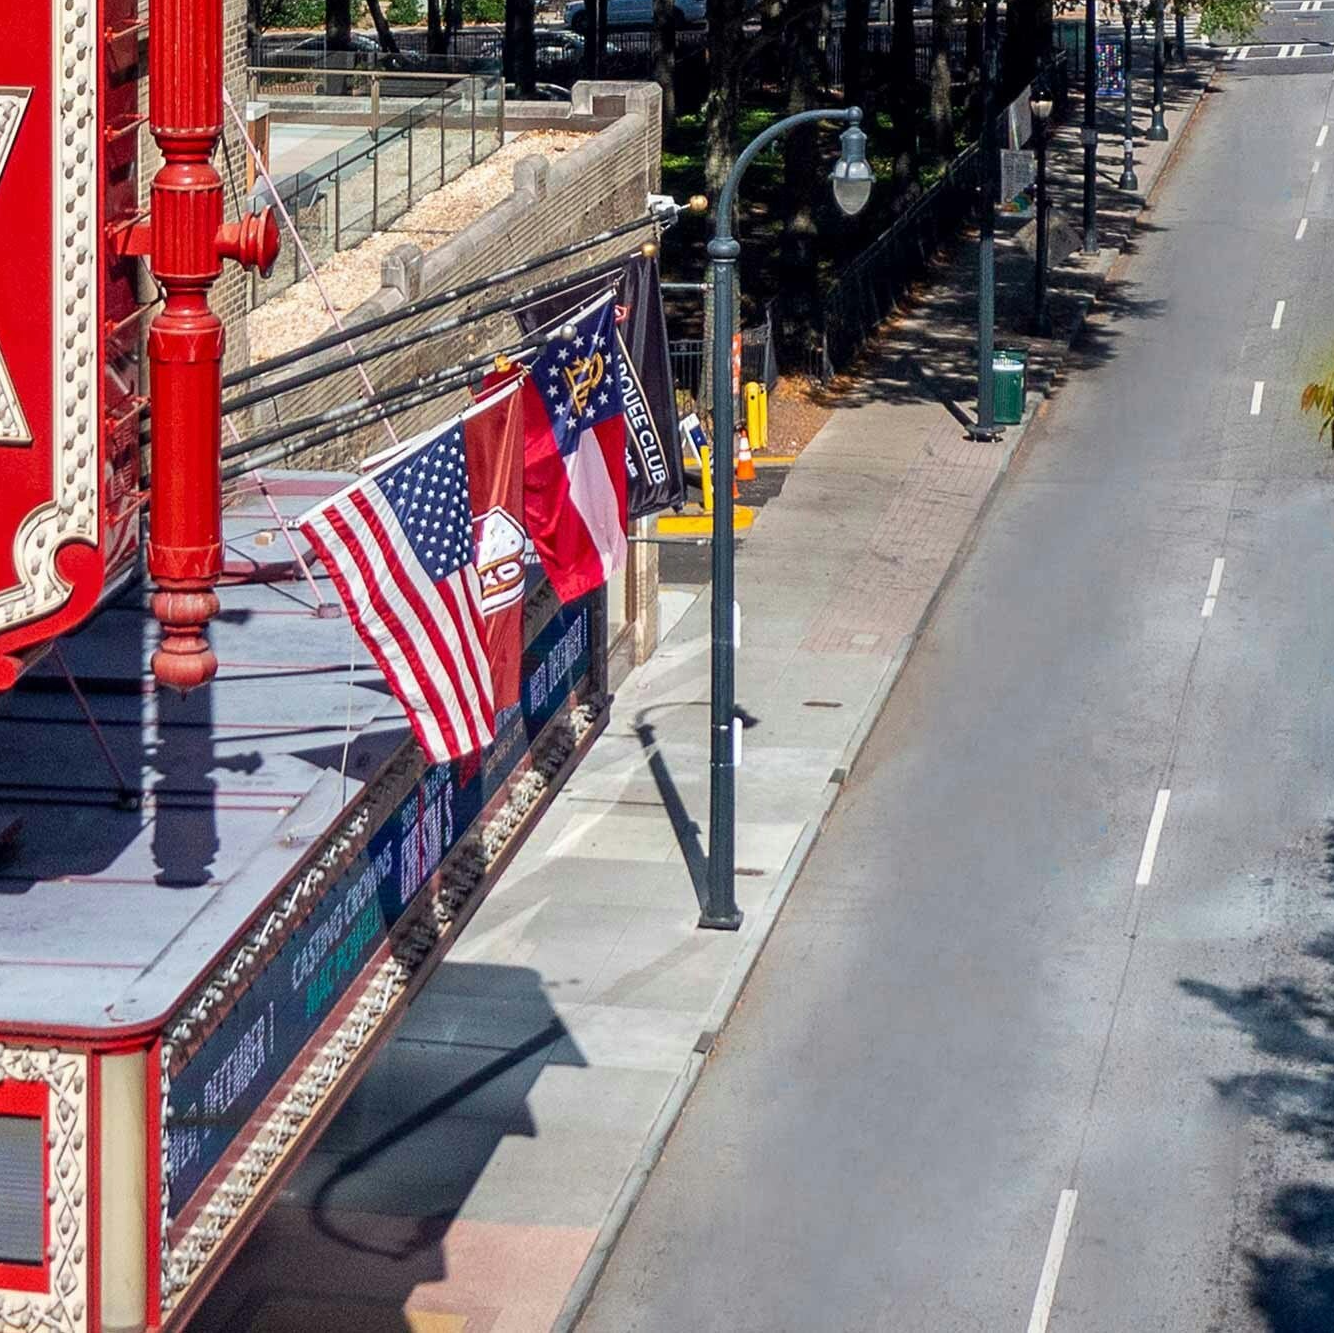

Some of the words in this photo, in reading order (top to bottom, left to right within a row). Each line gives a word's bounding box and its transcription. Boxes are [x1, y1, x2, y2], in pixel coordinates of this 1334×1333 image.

[639, 428, 667, 485] CLUB
[292, 902, 344, 991] CASTING
[344, 840, 393, 926] CROWNS
[203, 1014, 267, 1139] DECEMBER
